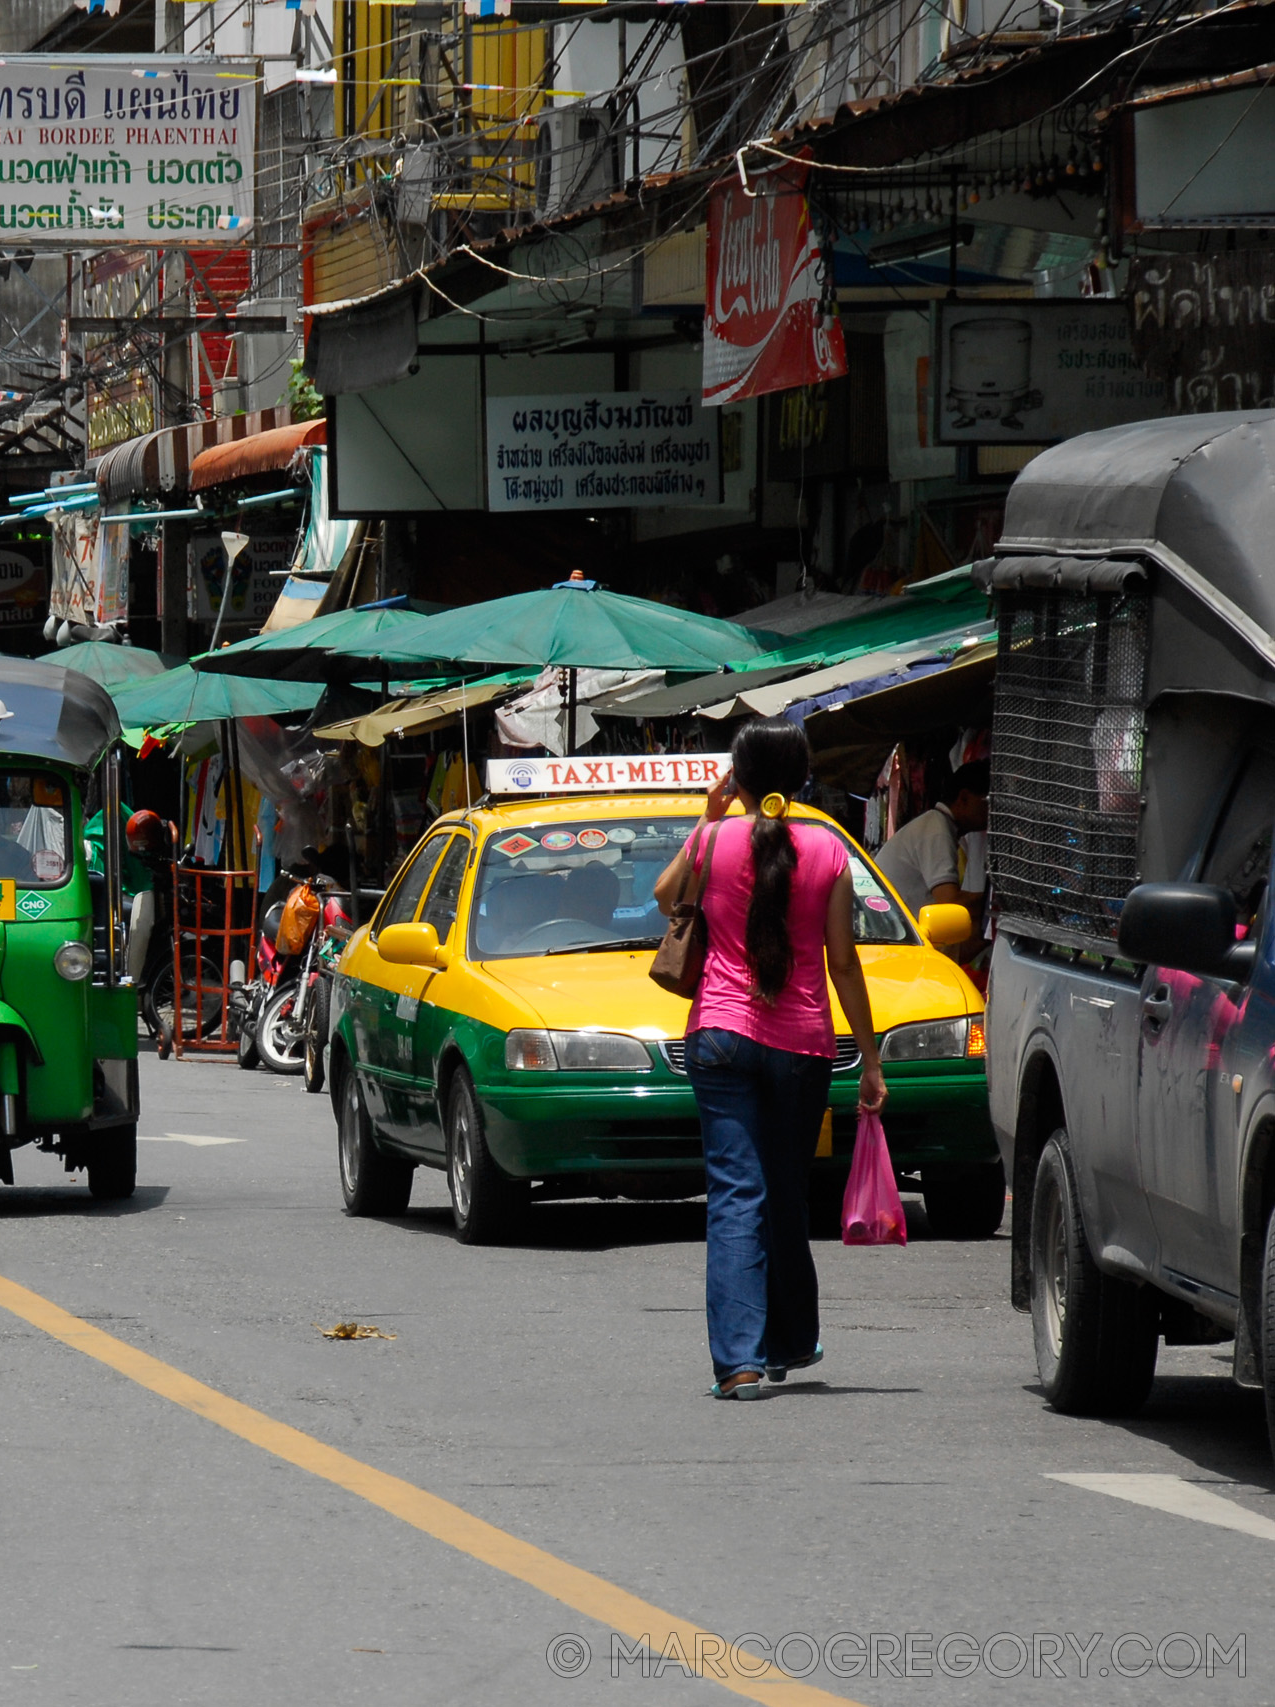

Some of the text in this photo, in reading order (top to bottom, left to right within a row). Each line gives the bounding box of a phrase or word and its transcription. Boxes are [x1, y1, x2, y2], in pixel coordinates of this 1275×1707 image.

[104, 69, 240, 120] แผนไทย
[39, 127, 115, 145] BORDEE
[126, 127, 238, 145] PHAENTHAI
[147, 151, 243, 184] นวดตัว
[497, 443, 543, 469] จำหน่าย
[651, 436, 711, 467] เครื่องบูชา
[253, 578, 285, 589] FOO
[546, 762, 720, 784] TAXI-METER
[22, 900, 45, 910] CNG
